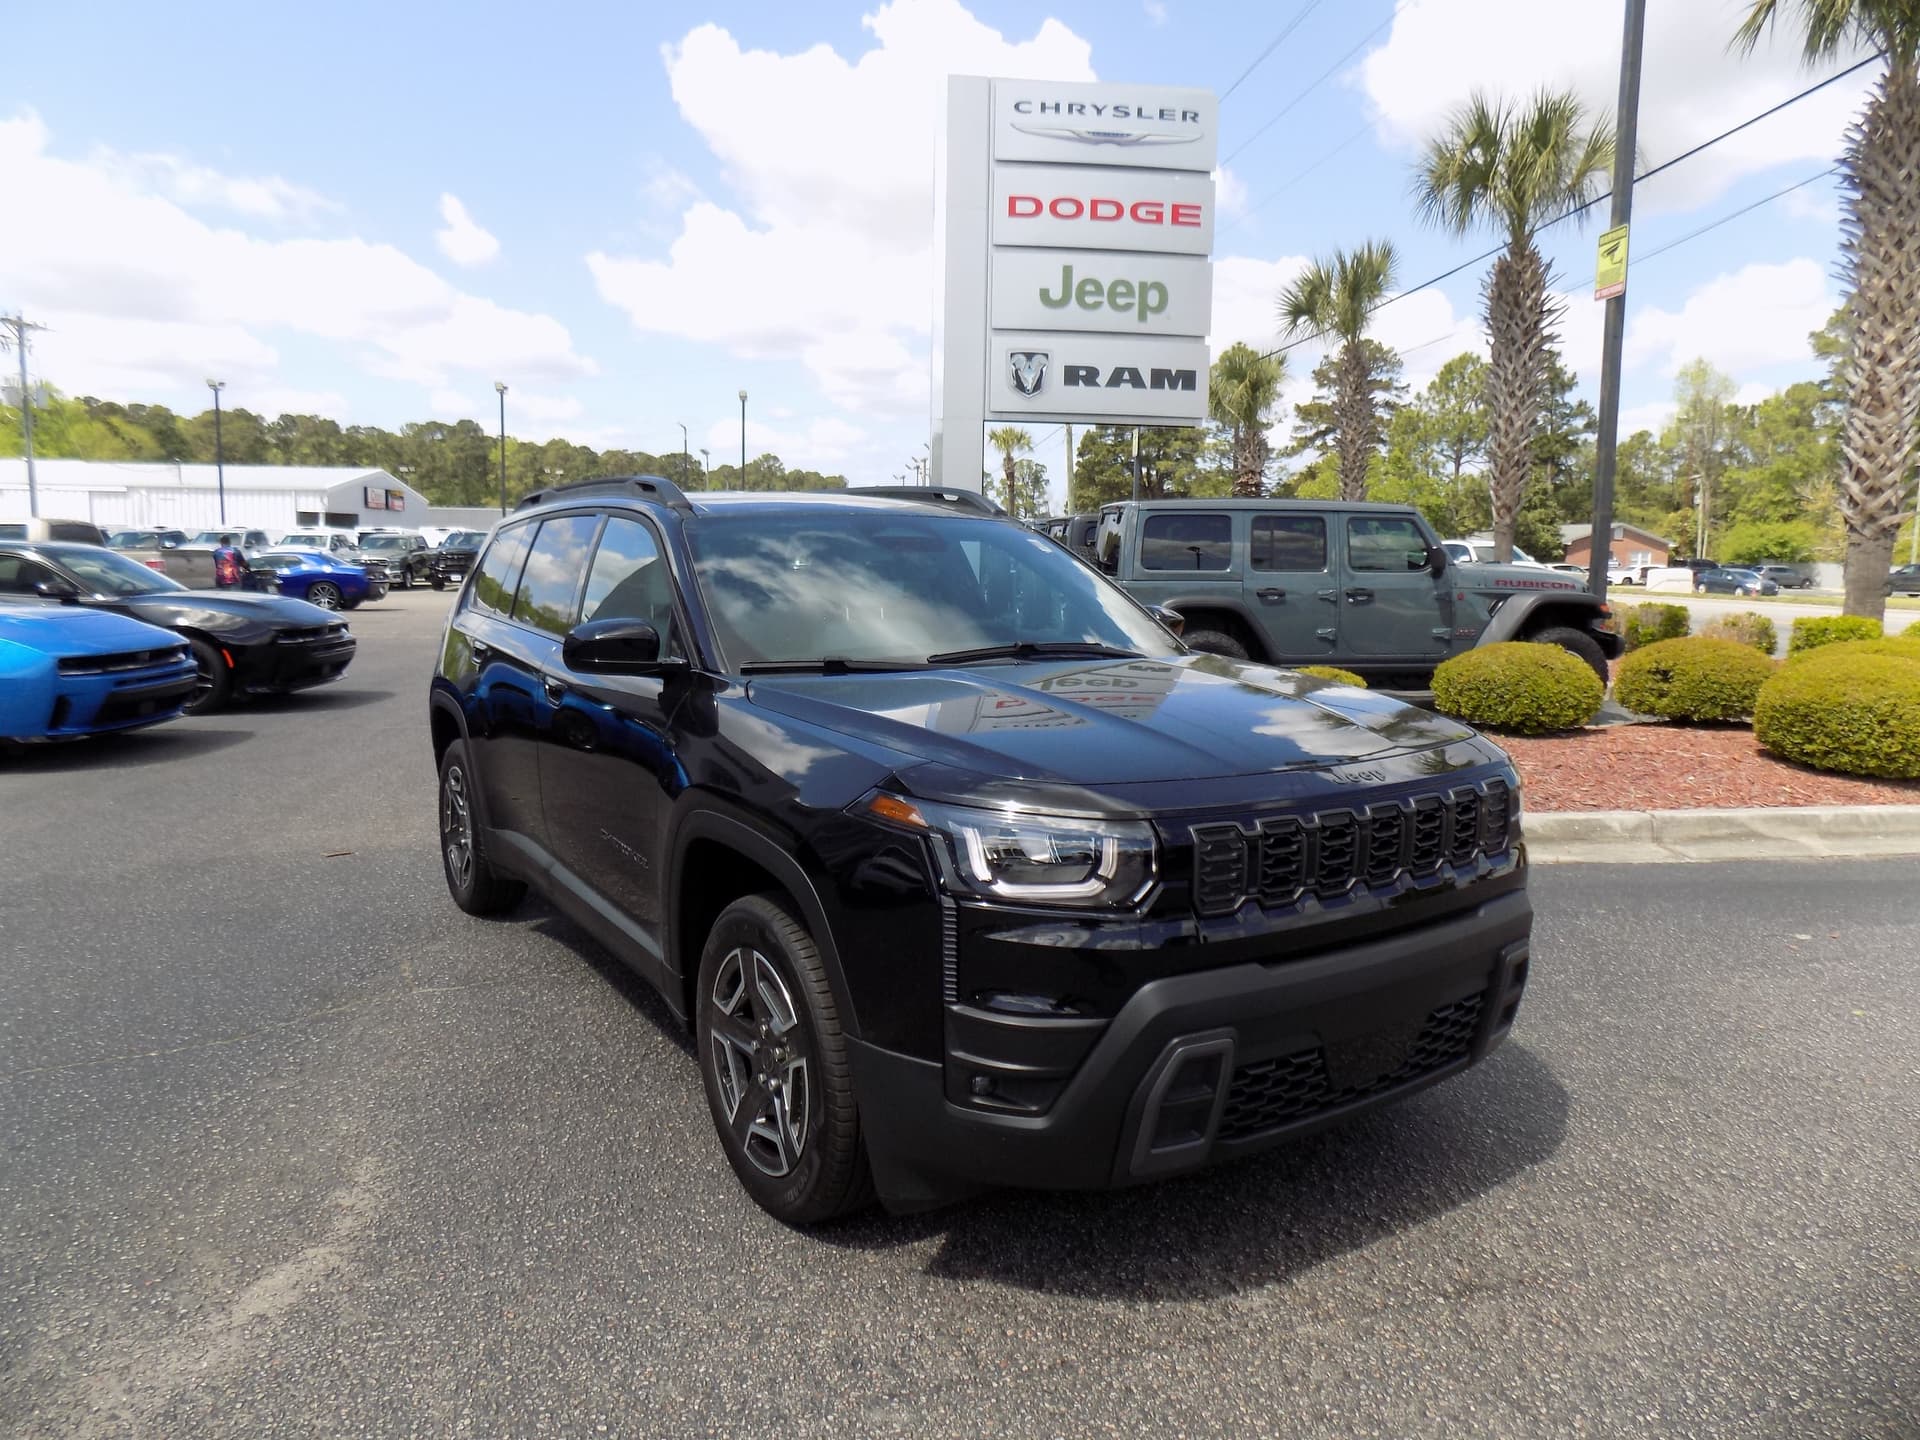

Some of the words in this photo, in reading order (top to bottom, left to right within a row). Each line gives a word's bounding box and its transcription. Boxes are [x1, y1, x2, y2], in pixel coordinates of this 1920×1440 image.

[1013, 100, 1201, 124] CHRYSLER
[1008, 195, 1202, 227] DODGE
[1039, 264, 1169, 323] Jeep
[1063, 364, 1197, 392] RAM
[1494, 579, 1577, 590] RUBICON
